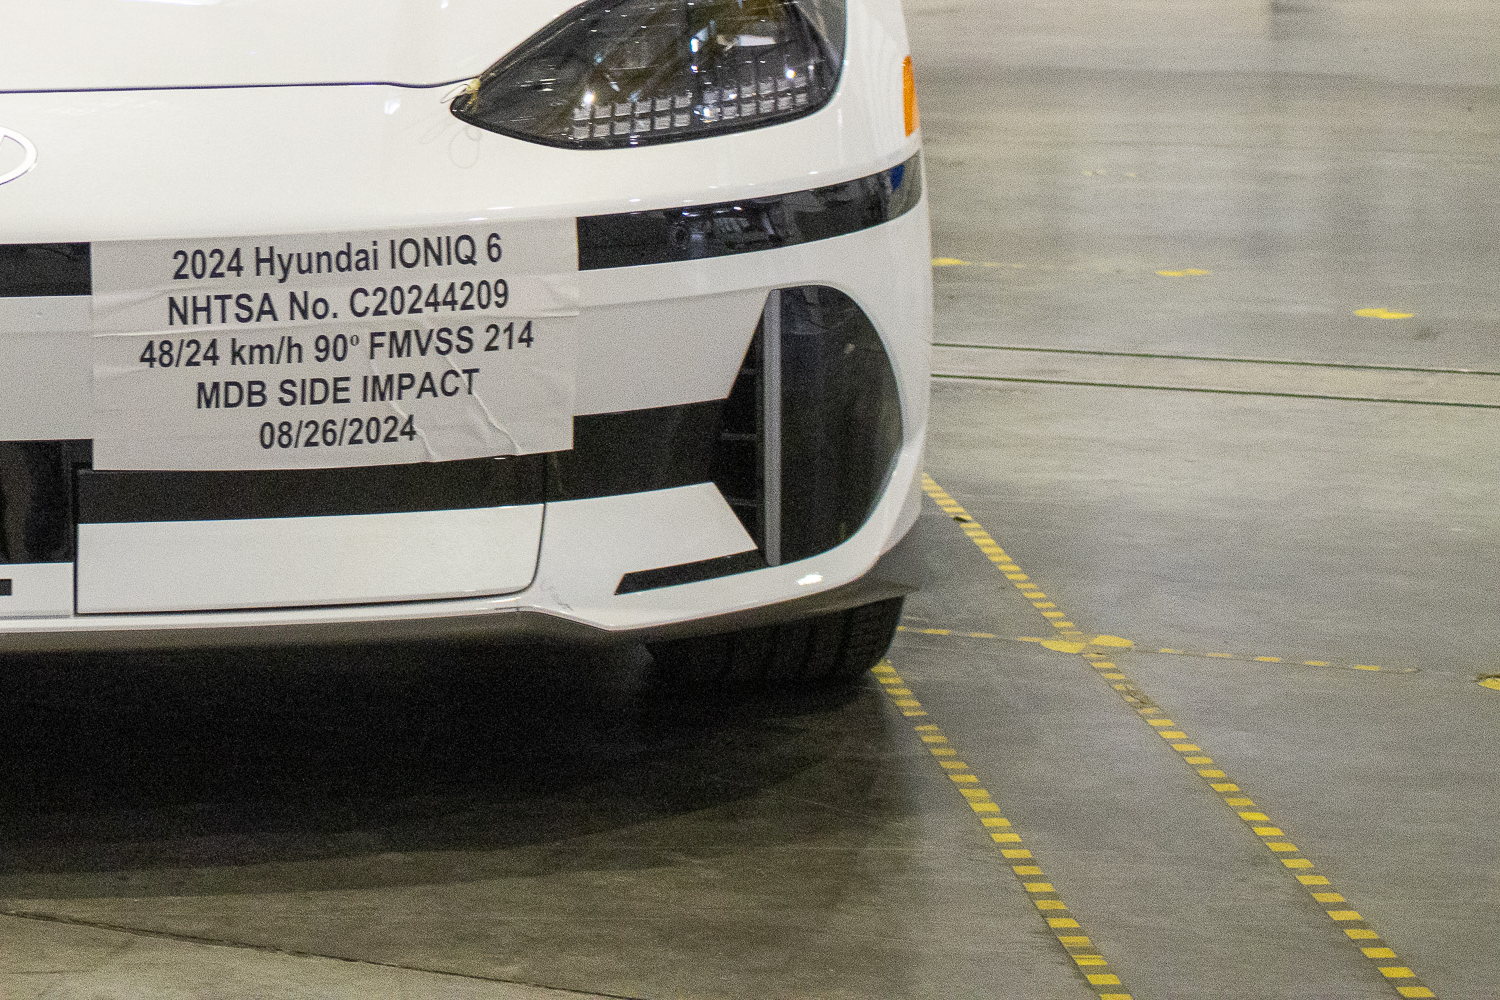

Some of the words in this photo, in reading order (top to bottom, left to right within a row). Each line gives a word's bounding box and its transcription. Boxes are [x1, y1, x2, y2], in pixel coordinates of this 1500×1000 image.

[172, 247, 244, 280] 2024
[254, 240, 379, 284] Hyundai
[389, 234, 478, 270] IONIQ
[486, 232, 503, 263] 6
[168, 292, 278, 326] NHTSA
[288, 290, 338, 321] No.
[349, 278, 510, 318] C20244209
[140, 338, 220, 369] 48/24
[231, 335, 303, 366] km/h
[369, 325, 474, 360] FMVSS
[485, 321, 534, 352] 214
[197, 380, 267, 409] MDB
[279, 376, 352, 407] SIDE
[362, 368, 480, 402] IMPACT
[259, 415, 417, 449] 08/26/2024
